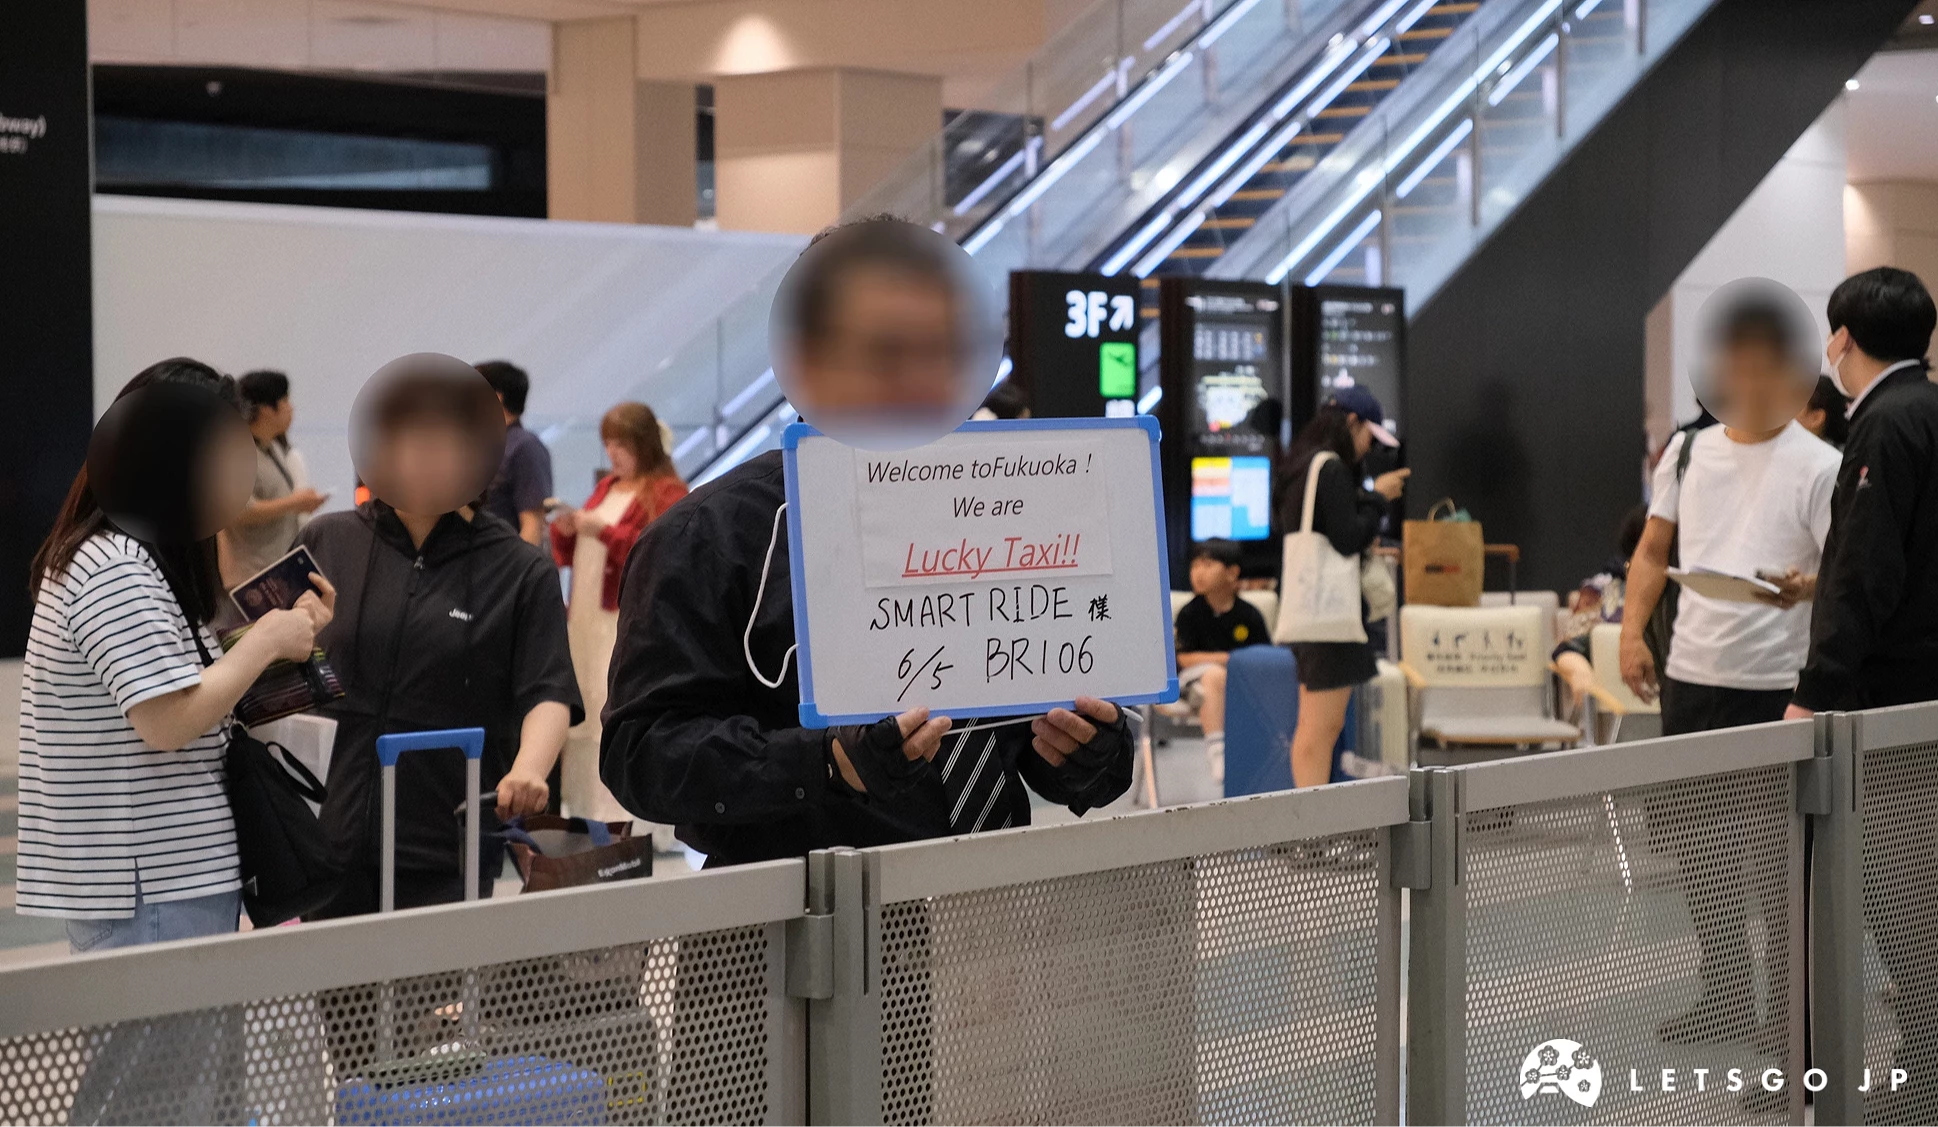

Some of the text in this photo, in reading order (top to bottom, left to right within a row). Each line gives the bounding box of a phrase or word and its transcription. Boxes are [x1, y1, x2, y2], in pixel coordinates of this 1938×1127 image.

[1064, 289, 1108, 339] 3F
[868, 459, 964, 483] Welcome
[971, 453, 1077, 481] toFukuoka
[953, 496, 1024, 518] We are
[902, 534, 1081, 579] Lucky Taxi!!
[869, 584, 1112, 631] SMART RIDE 様
[896, 635, 1094, 703] 6/5 BR106
